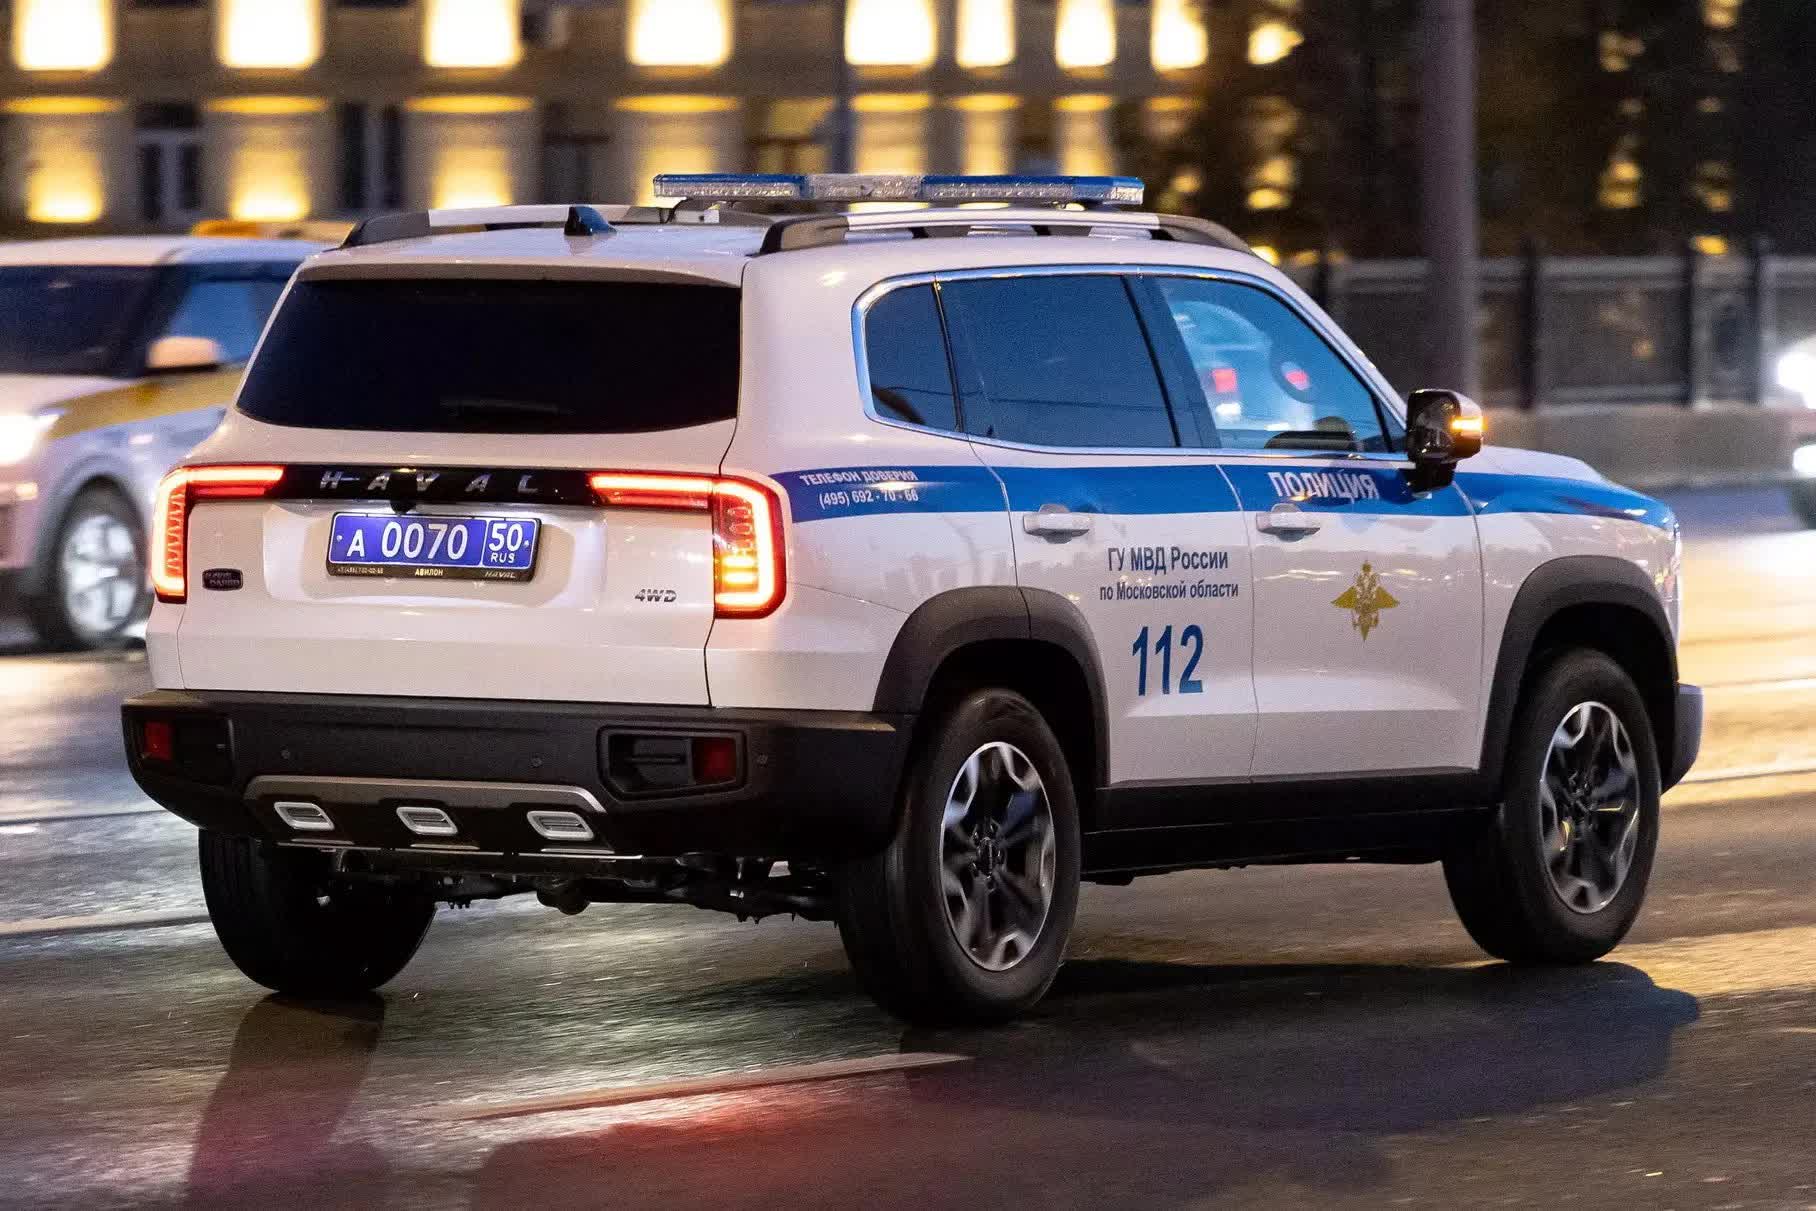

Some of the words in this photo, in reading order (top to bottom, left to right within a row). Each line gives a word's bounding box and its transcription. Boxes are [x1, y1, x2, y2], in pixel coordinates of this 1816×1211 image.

[320, 471, 538, 494] HAVAL
[800, 472, 862, 486] ТЕЛЕФОН
[862, 470, 918, 483] ДОВЕРИЯ
[1267, 472, 1380, 504] ПОЛИЦИЯ
[818, 491, 850, 510] (495)
[851, 490, 874, 503] 692
[381, 521, 468, 560] 0070
[488, 523, 523, 551] 50
[490, 552, 515, 564] RUS
[1107, 547, 1126, 571] ГУ
[1130, 546, 1167, 576] МВД
[1171, 546, 1228, 570] России
[414, 568, 443, 577] АВИЛОН
[634, 588, 677, 602] 4WD
[1100, 586, 1113, 600] по
[1116, 580, 1187, 600] Московской
[1190, 579, 1239, 598] области
[1132, 624, 1204, 697] 112
